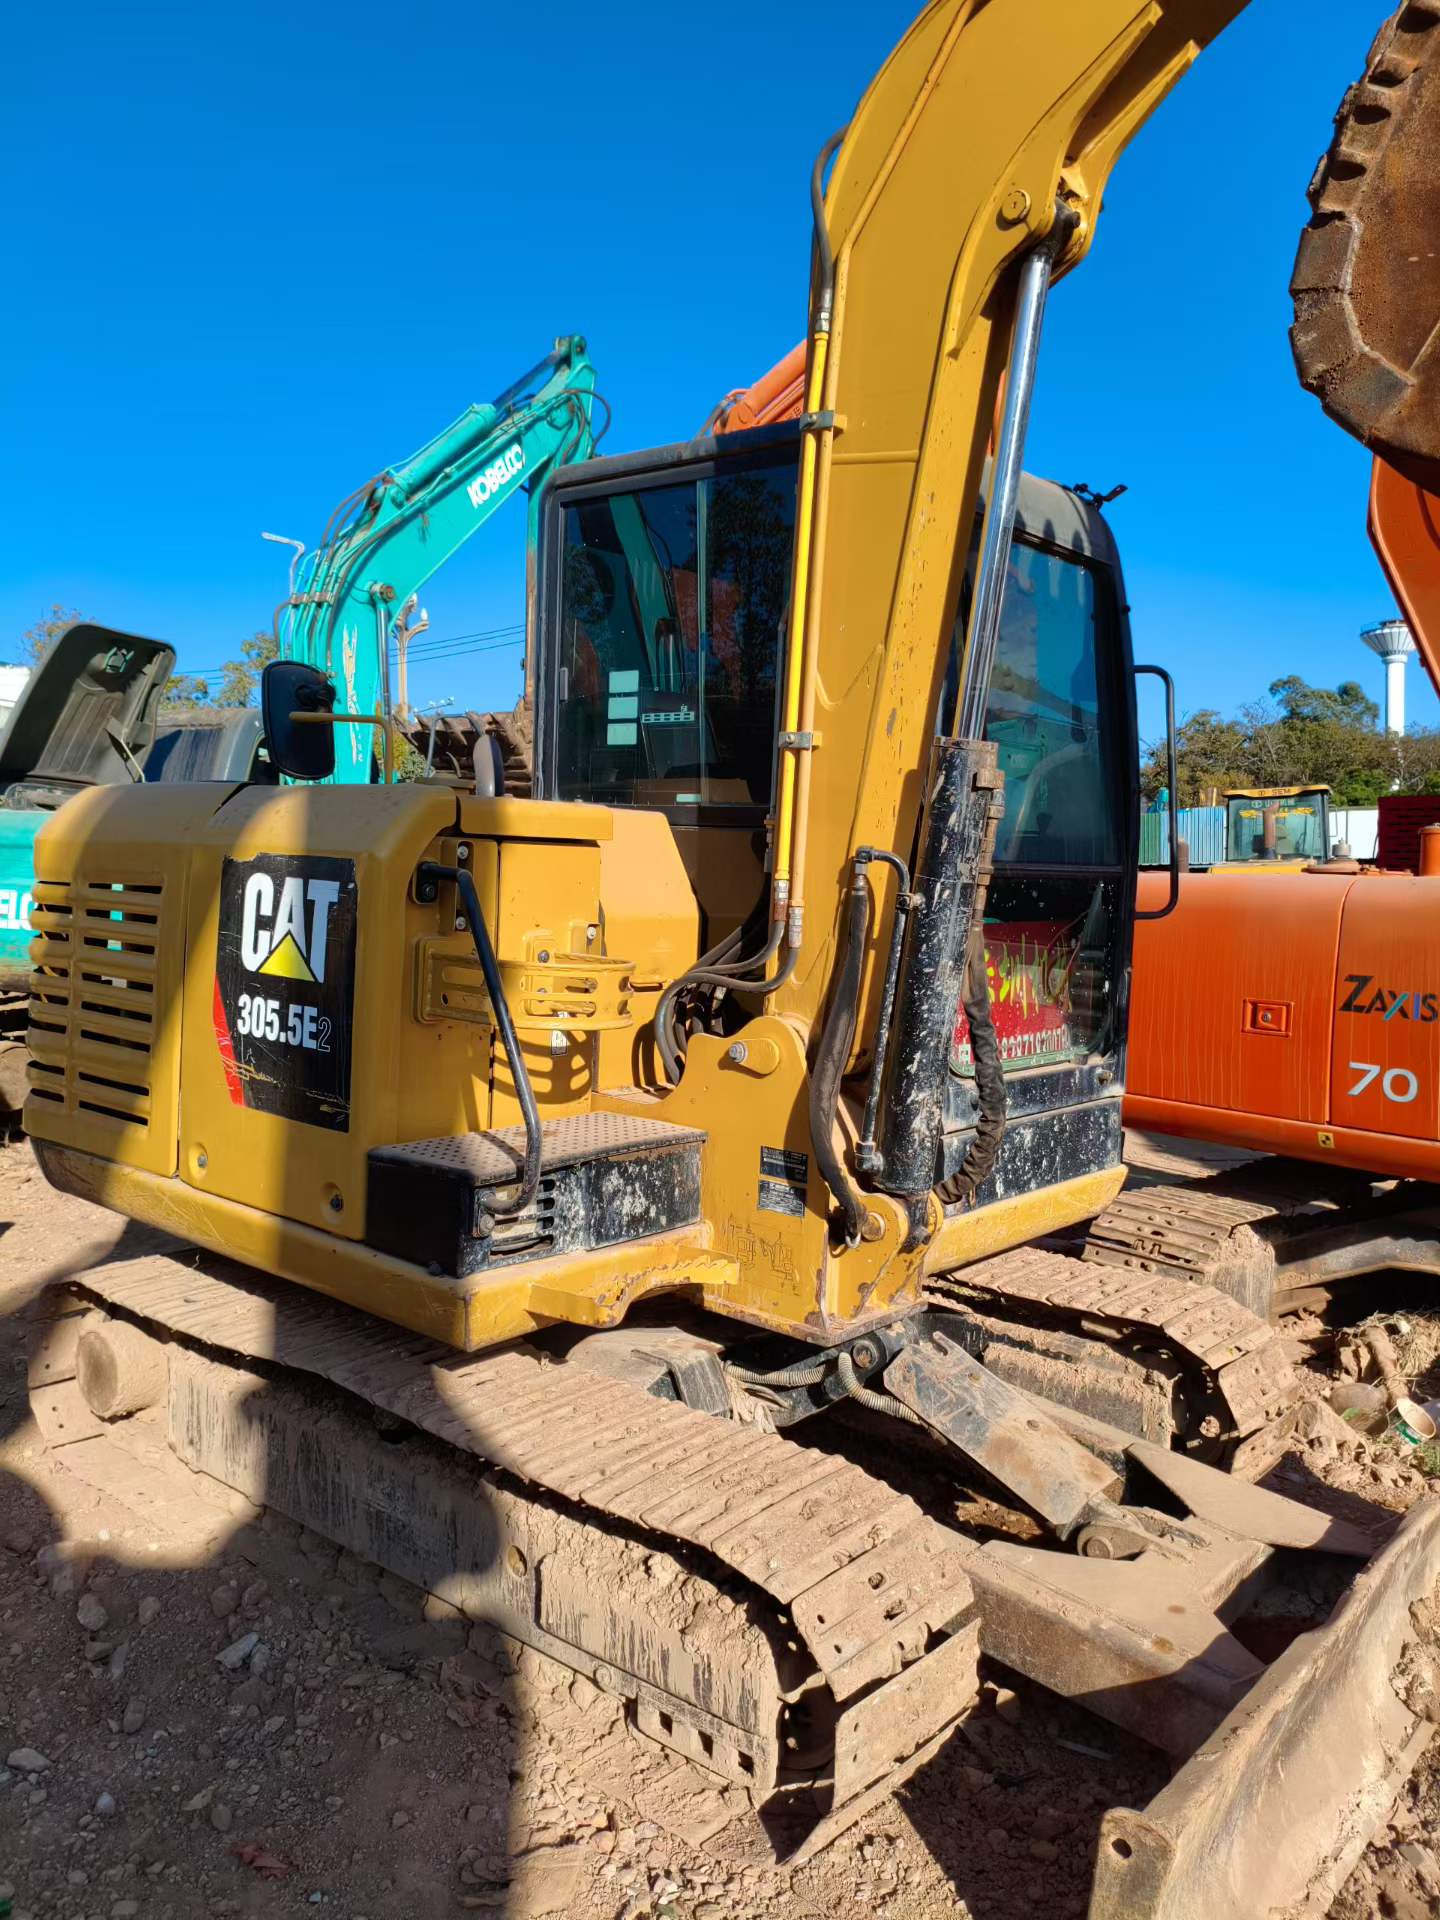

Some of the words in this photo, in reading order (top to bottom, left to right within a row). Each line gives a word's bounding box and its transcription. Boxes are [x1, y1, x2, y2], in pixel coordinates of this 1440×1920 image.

[466, 443, 526, 509] KOBELCO
[241, 872, 341, 985] CAT
[236, 993, 332, 1053] 305.5E2
[1338, 974, 1439, 1022] ZAXIS
[1347, 1061, 1419, 1103] 70
